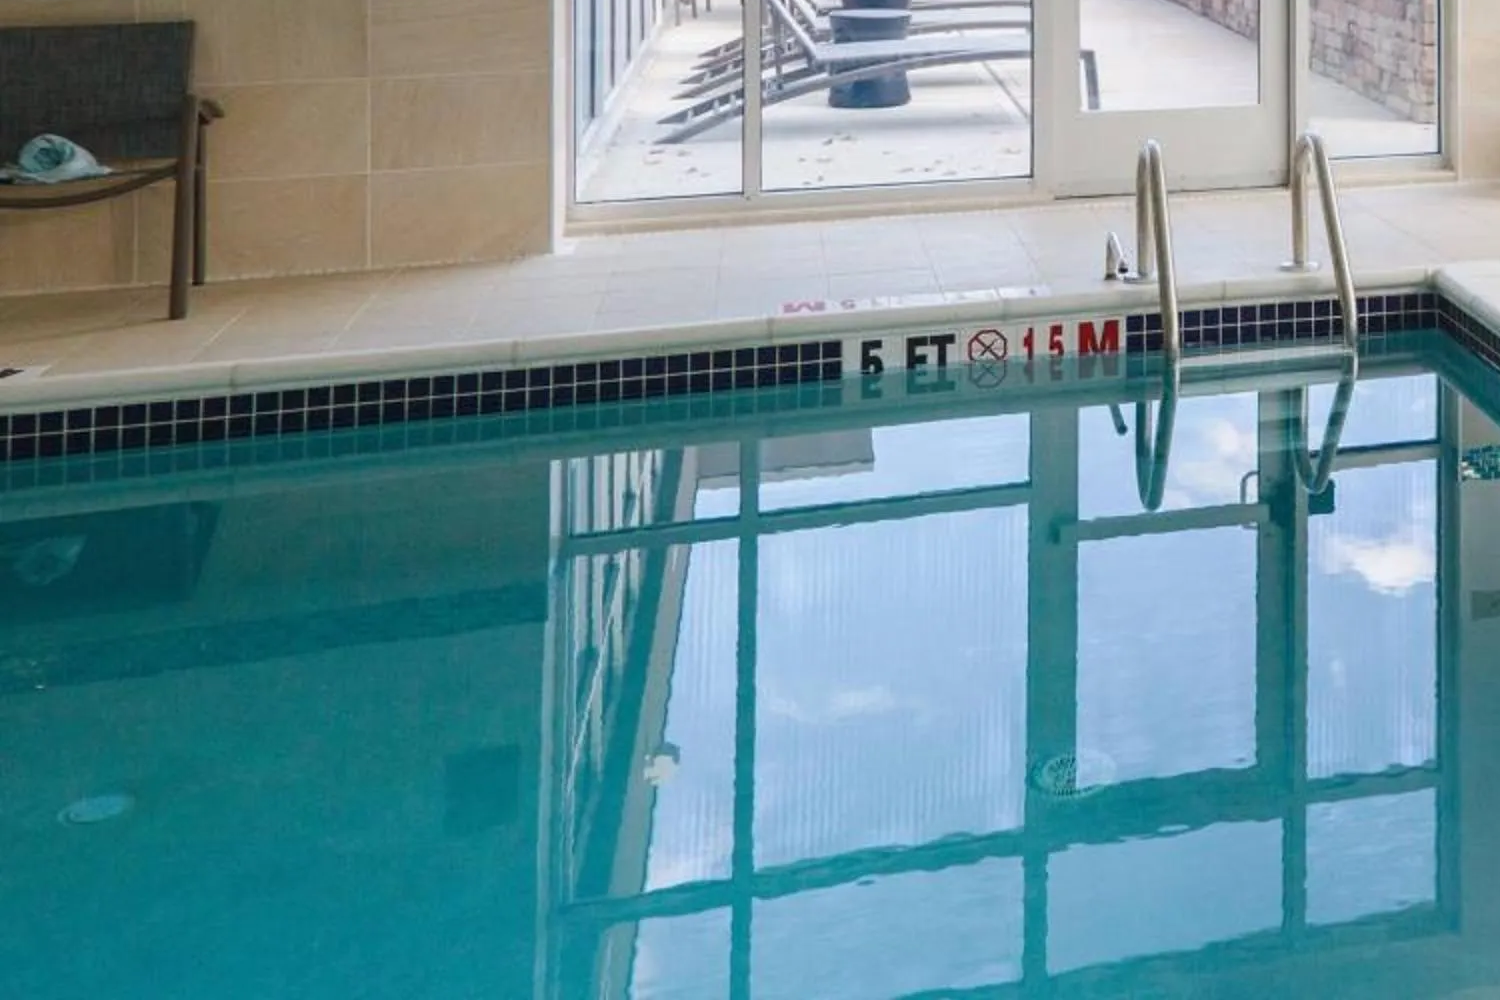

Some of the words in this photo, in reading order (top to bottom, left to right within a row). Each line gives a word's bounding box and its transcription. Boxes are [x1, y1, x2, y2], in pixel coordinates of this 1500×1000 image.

[861, 340, 884, 375] 5
[906, 334, 956, 370] FT
[1078, 319, 1120, 356] M
